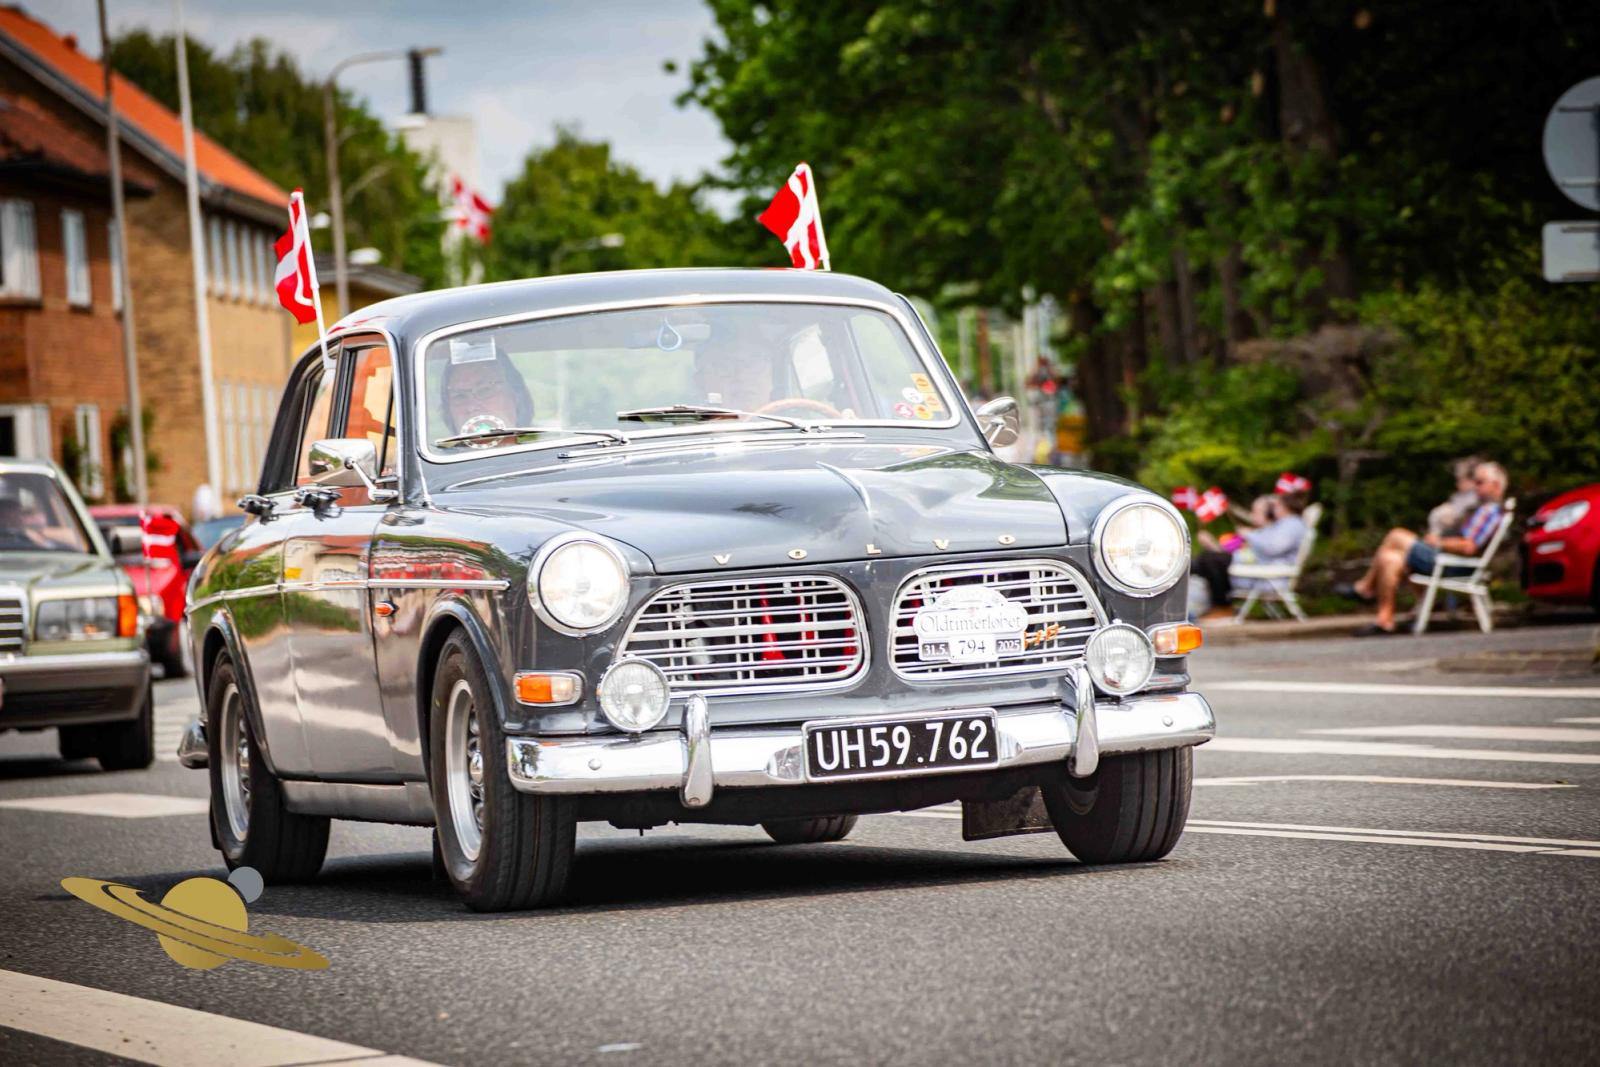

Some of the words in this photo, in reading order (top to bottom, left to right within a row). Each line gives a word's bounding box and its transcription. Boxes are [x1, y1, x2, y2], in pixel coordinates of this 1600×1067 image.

[713, 534, 1016, 564] VOLVO
[958, 640, 986, 655] 794
[997, 639, 1020, 651] 2025
